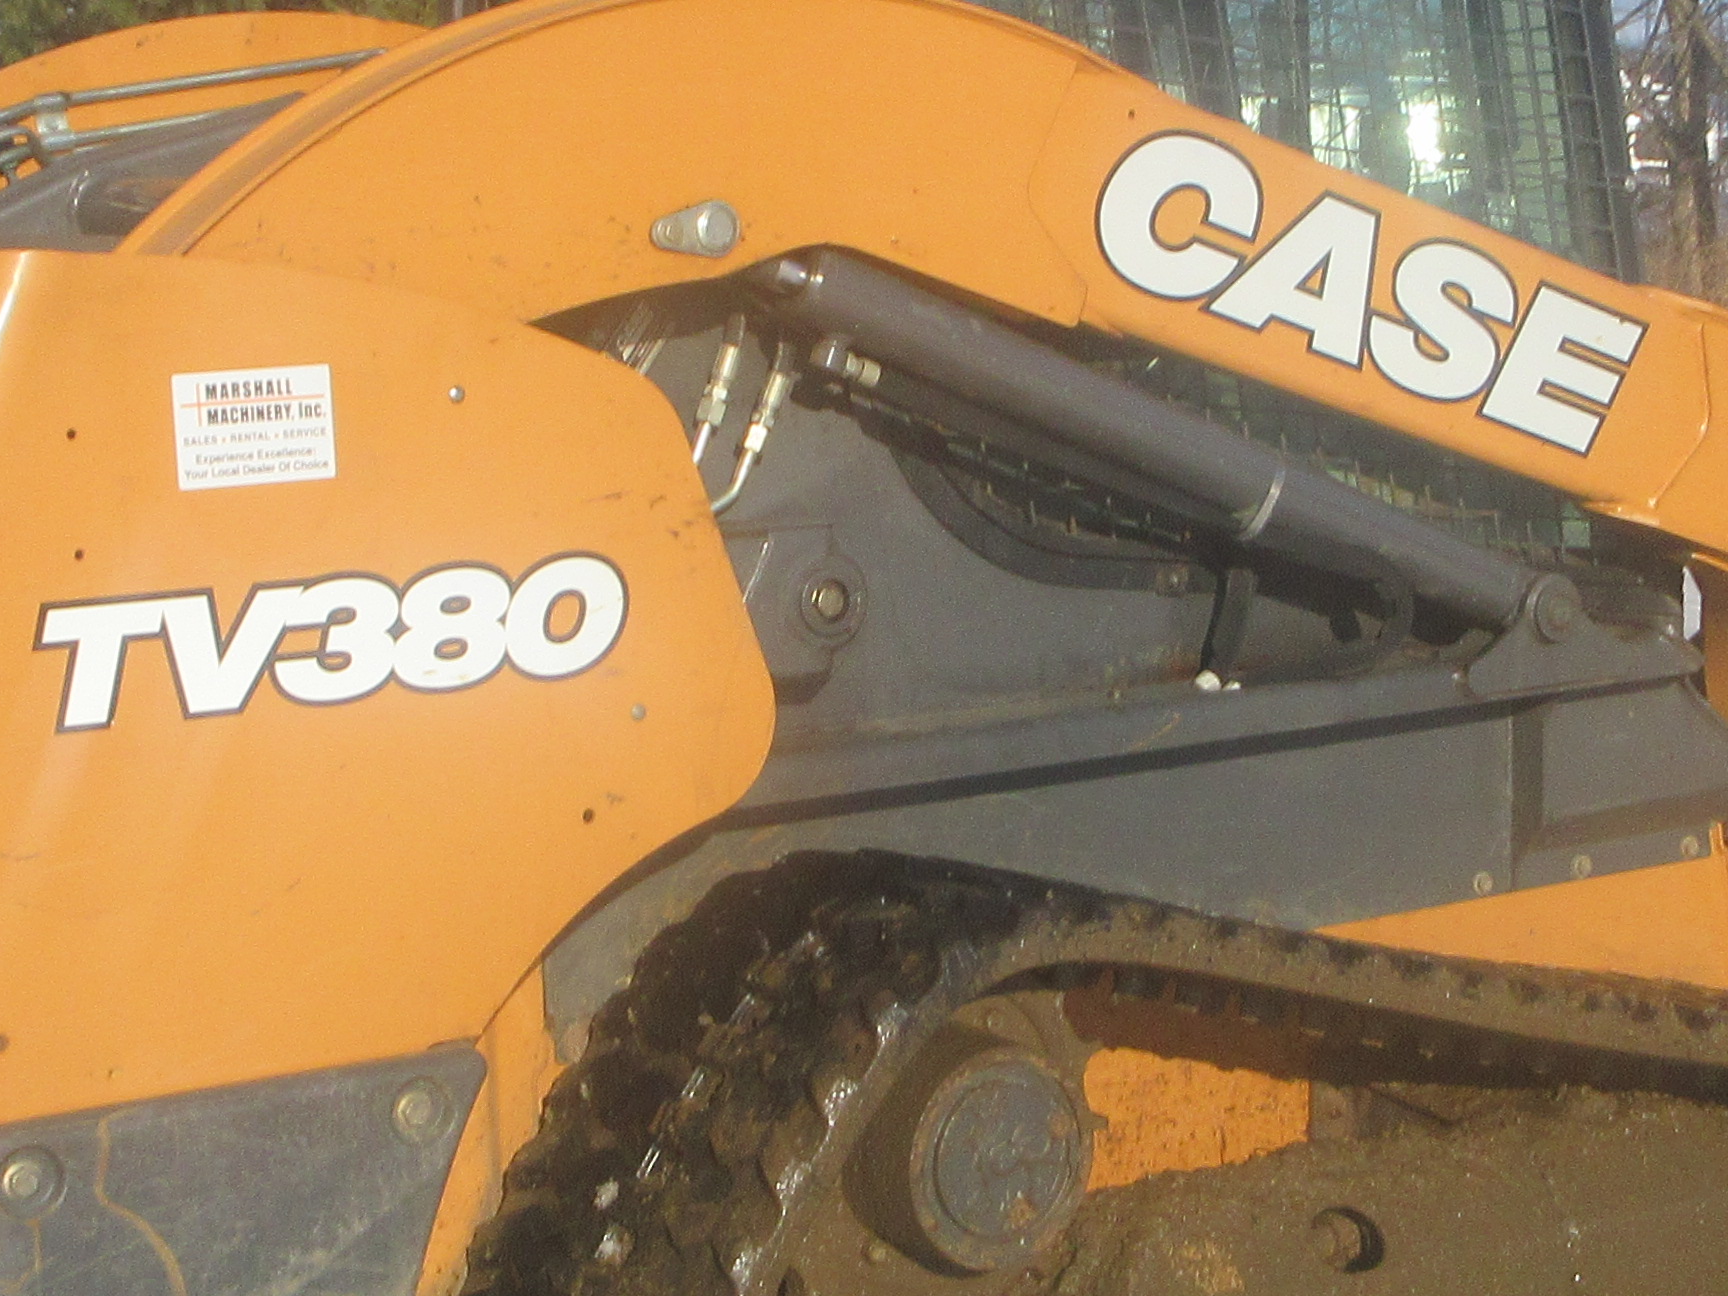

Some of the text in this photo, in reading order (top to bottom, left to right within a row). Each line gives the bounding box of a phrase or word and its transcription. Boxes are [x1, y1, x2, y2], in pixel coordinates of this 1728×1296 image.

[1094, 129, 1650, 457] CASE
[205, 377, 293, 400] MARSHALL
[298, 402, 327, 419] Inc.
[183, 427, 327, 447] SALES RENTAL SERVICE
[184, 469, 208, 480] Your
[211, 467, 240, 478] Local
[242, 464, 275, 477] Dealer
[293, 459, 329, 471] Choice
[195, 452, 254, 466] Experience
[32, 550, 629, 733] TV380
